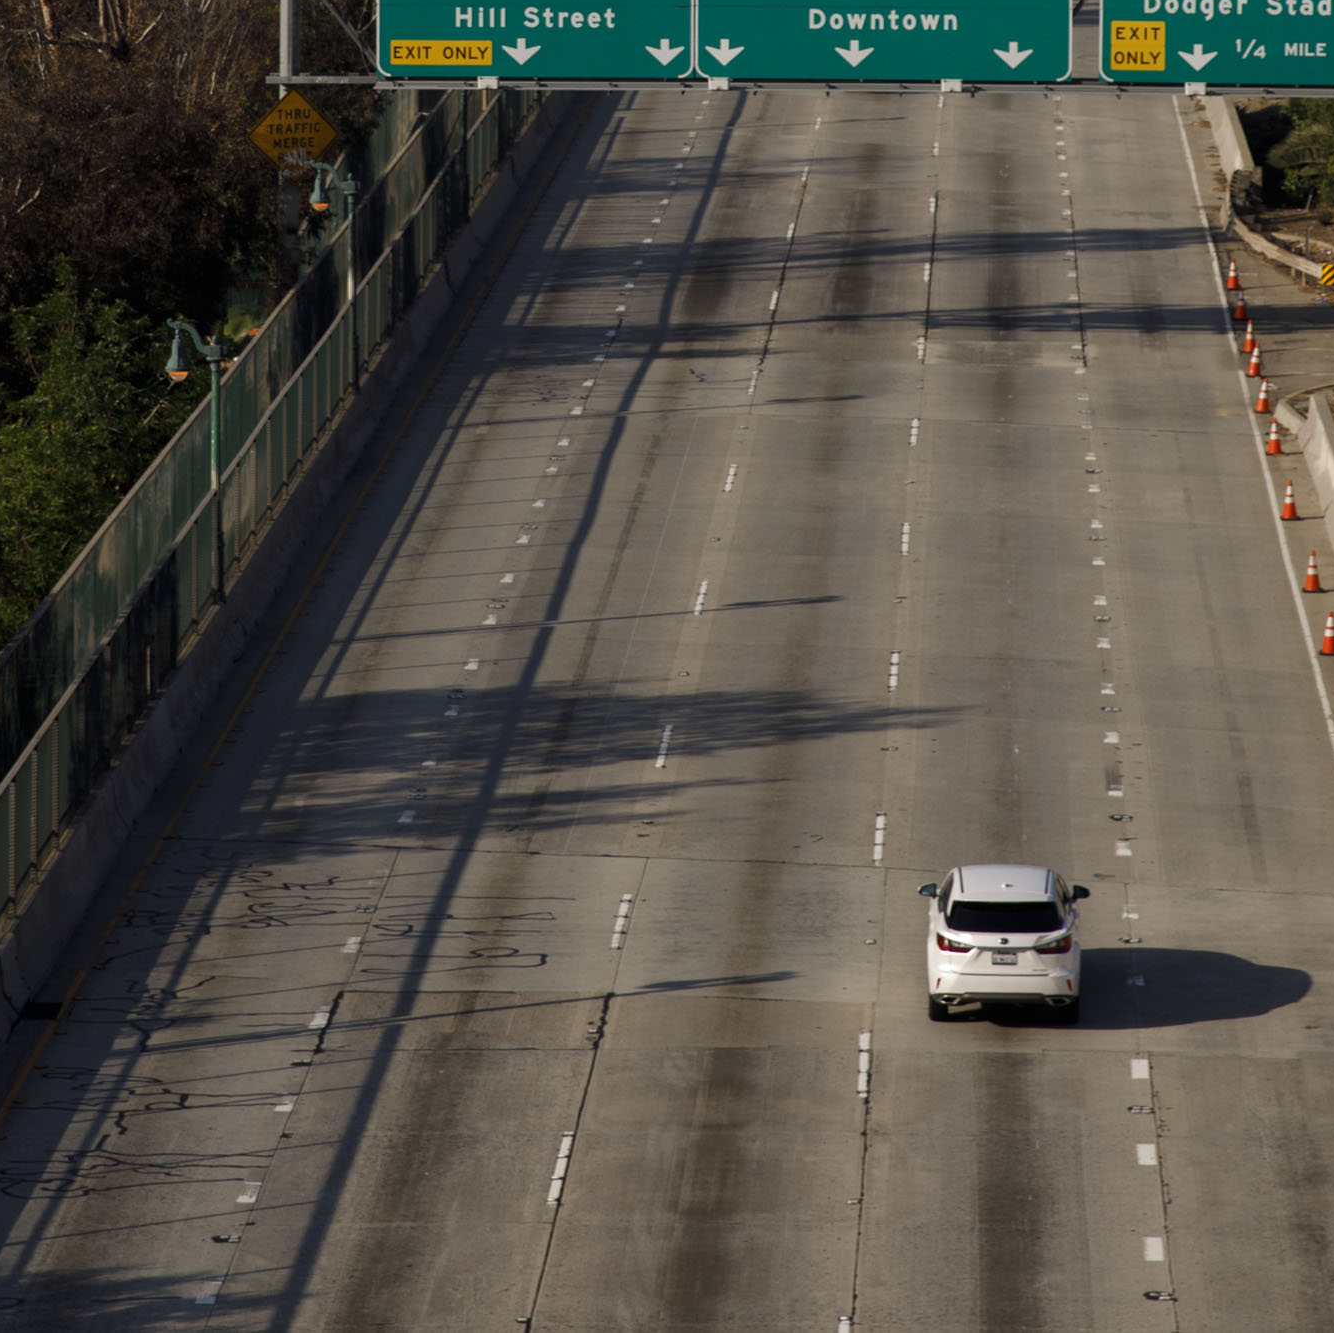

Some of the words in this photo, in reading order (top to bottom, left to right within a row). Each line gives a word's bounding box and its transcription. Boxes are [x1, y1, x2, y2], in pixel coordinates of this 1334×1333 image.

[455, 6, 507, 28] Hill
[523, 6, 616, 28] Street
[808, 8, 959, 31] Downtown
[1115, 26, 1161, 41] EXIT
[393, 45, 432, 60] EXIT
[443, 45, 490, 60] ONLY
[1284, 42, 1327, 57] MILE
[1113, 51, 1161, 65] ONLY
[276, 108, 311, 120] THRU
[268, 122, 321, 135] TRAFFIC
[273, 137, 315, 148] MERGE
